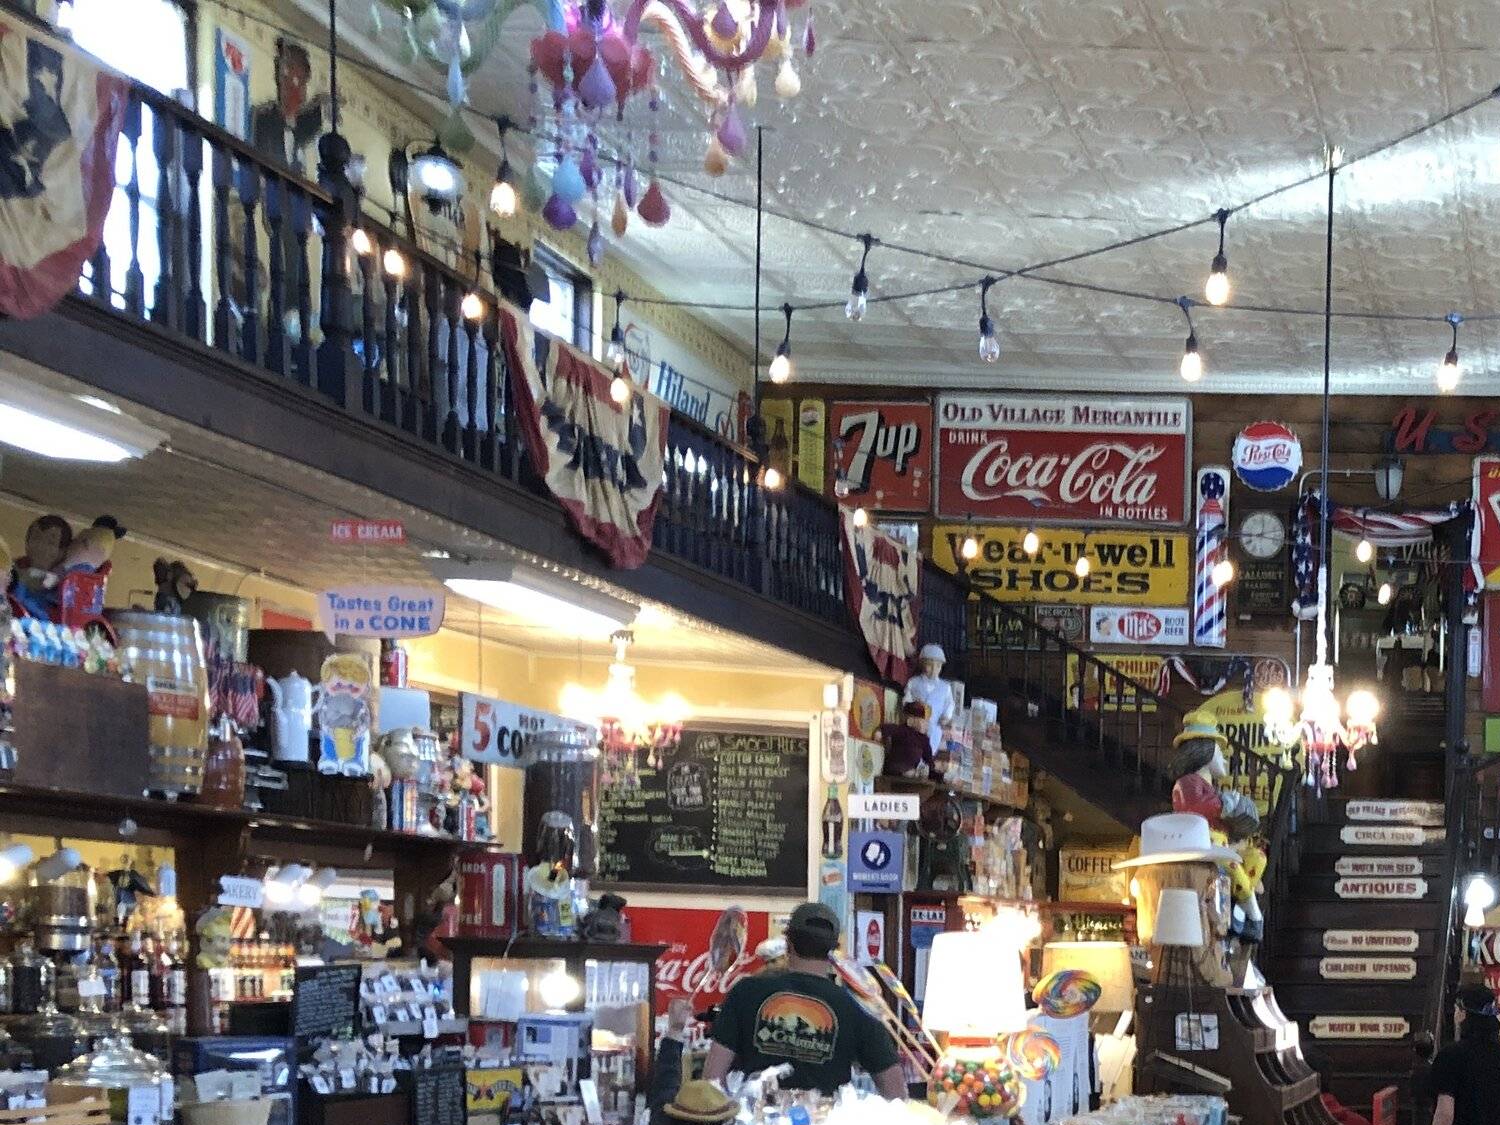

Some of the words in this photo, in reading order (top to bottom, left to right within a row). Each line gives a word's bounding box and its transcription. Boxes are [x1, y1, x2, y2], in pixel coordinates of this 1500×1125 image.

[657, 360, 710, 424] Hiland
[943, 403, 984, 423] OLD
[989, 404, 1066, 424] VILLAGE
[1072, 405, 1182, 428] MERCANTILE
[948, 429, 988, 445] DRINK
[960, 438, 1167, 506] Coca-Cola
[1100, 505, 1114, 519] IN
[1117, 505, 1168, 521] BOTTLES
[333, 522, 352, 539] ICE
[357, 523, 403, 539] CREAM
[970, 566, 1151, 596] SHOES
[326, 591, 382, 612] Tastes
[387, 595, 434, 612] Great
[334, 613, 350, 630] in
[355, 617, 365, 630] a
[368, 614, 431, 632] CONE
[518, 714, 545, 732] HOT
[864, 801, 909, 813] LADIES
[1355, 830, 1386, 841] CIRCA
[1341, 882, 1417, 894] ANTIQUES
